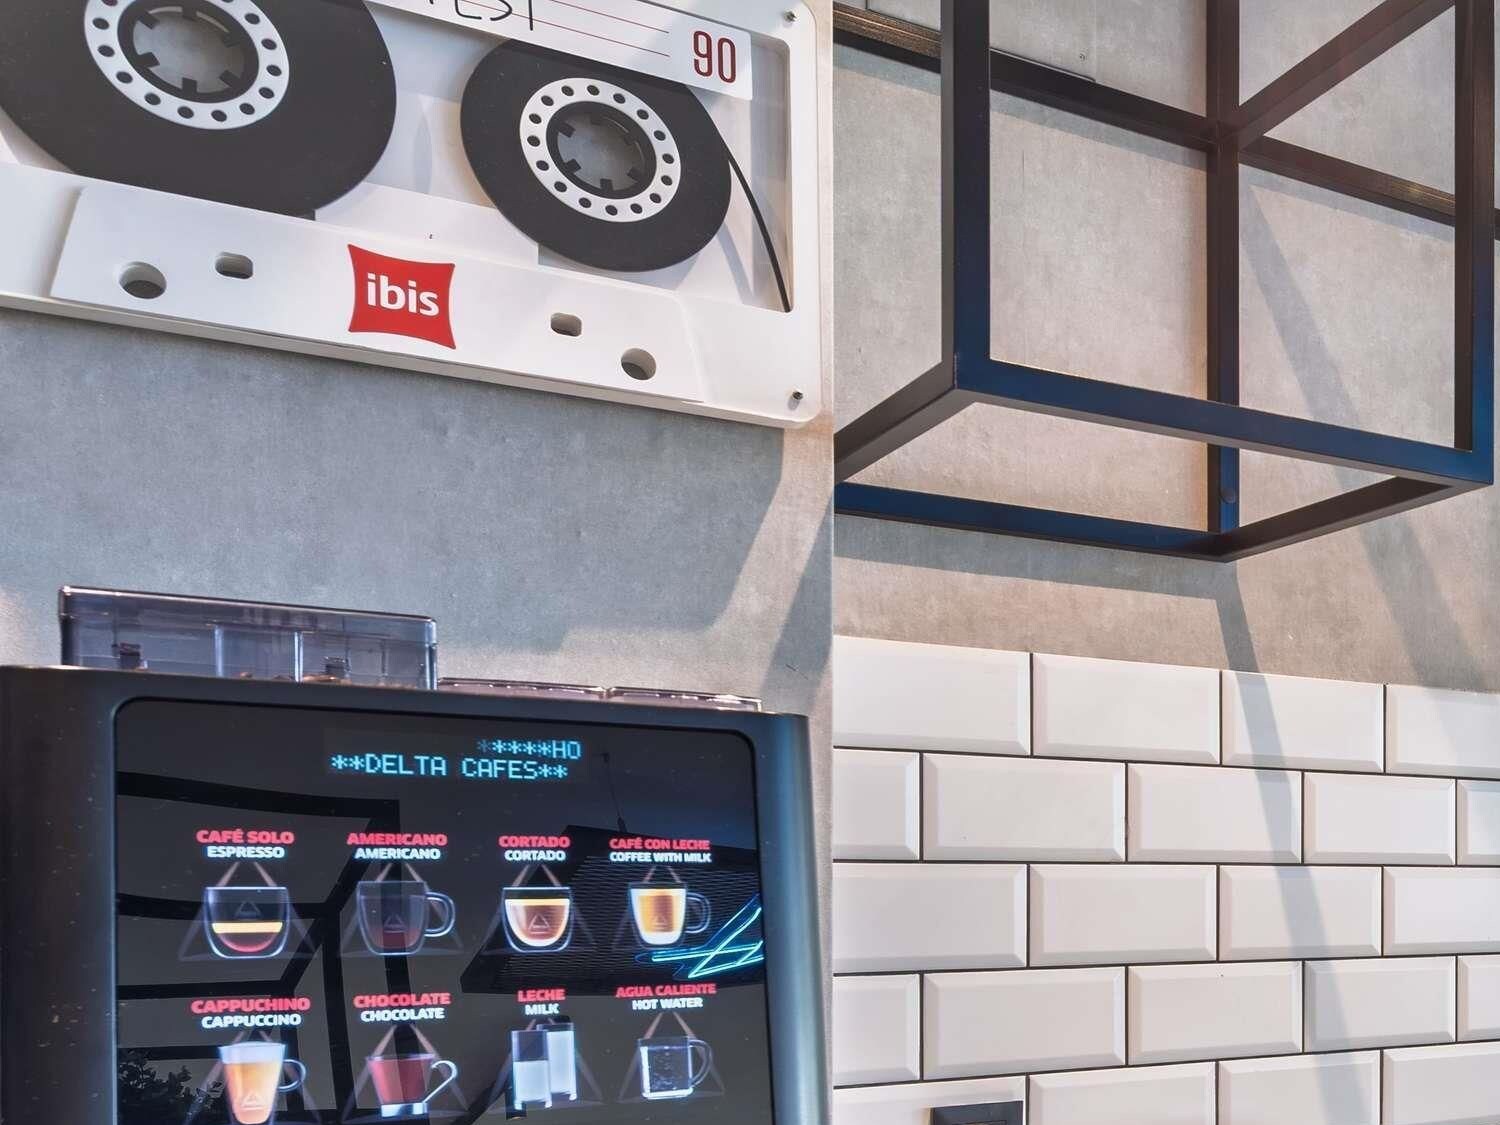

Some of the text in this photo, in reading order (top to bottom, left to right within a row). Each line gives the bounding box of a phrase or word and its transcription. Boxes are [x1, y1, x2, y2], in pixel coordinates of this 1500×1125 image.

[692, 30, 737, 84] 90
[367, 272, 439, 317] ibis
[196, 828, 295, 844] CAFÉ SOLO
[347, 832, 448, 846] AMERICANO
[499, 835, 571, 848] CORTADO
[609, 836, 710, 850] CAFÉ CON LECHE
[207, 845, 285, 859] ESPRESSO
[354, 847, 441, 860] AMERICANO
[504, 849, 567, 862] CORTADO
[609, 851, 712, 863] COFFEE WITH MILK
[517, 988, 566, 1003] LECHE
[615, 983, 717, 999] AGUA CALIENTE
[191, 997, 311, 1014] CAPPUCHINO
[354, 993, 451, 1008] CHOCOLATE
[632, 997, 704, 1010] HOT WATER
[360, 1008, 446, 1023] CHOCOLATE
[524, 1003, 560, 1015] MILK
[201, 1013, 302, 1029] CAPPUCCINO
